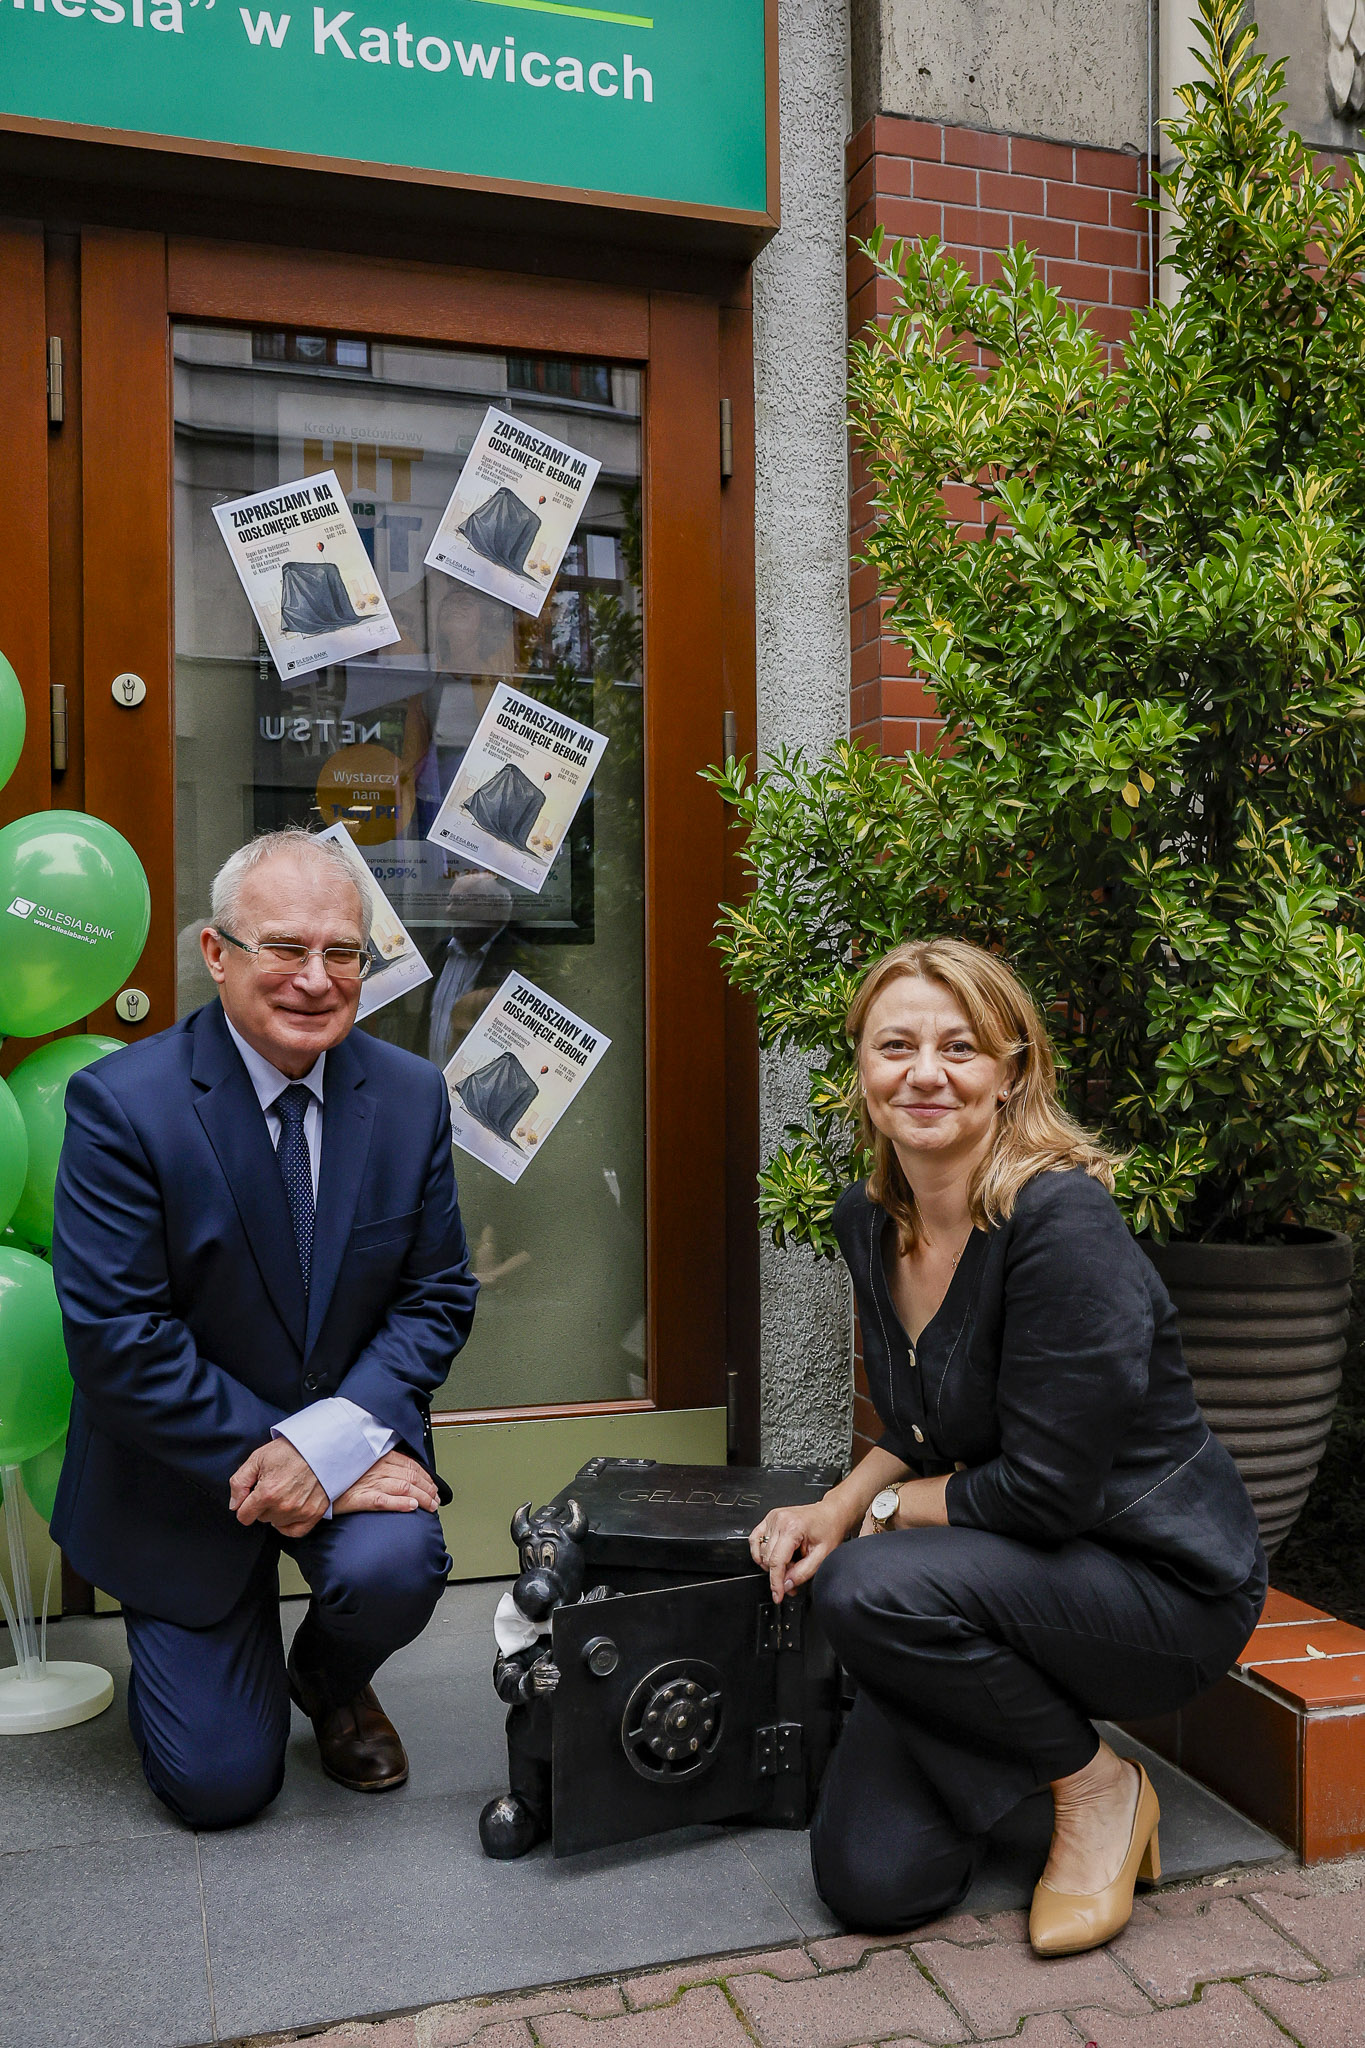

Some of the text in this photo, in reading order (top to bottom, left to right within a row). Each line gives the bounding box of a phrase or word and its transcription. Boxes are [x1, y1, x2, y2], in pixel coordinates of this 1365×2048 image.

[239, 7, 291, 49] w
[313, 6, 654, 103] Katowicach
[304, 422, 423, 443] Kredyt gotówkowy
[494, 420, 587, 477] ZAPRASZAMY NA
[304, 438, 425, 503] HIT
[488, 437, 581, 491] ODSŁONIĘCIE BEBOKA
[230, 484, 332, 527] ZAPRASZAMY NA
[238, 502, 339, 542] ODSŁONIĘCIE BEBOKA
[353, 502, 376, 517] na
[497, 714, 587, 767] ODSŁONIĘCIE BEBOKA
[502, 697, 593, 753] ZAPRASZAMY NA
[333, 770, 400, 787] Wystarczy
[352, 790, 381, 801] nam
[33, 918, 98, 945] www.silesiabank.pl
[36, 905, 116, 941] SILESIA BANK
[503, 1001, 587, 1066] ODSŁONIĘCIE BEBOKA
[511, 985, 596, 1052] ZAPRASZAMY NA
[618, 1489, 762, 1508] GELDUS
